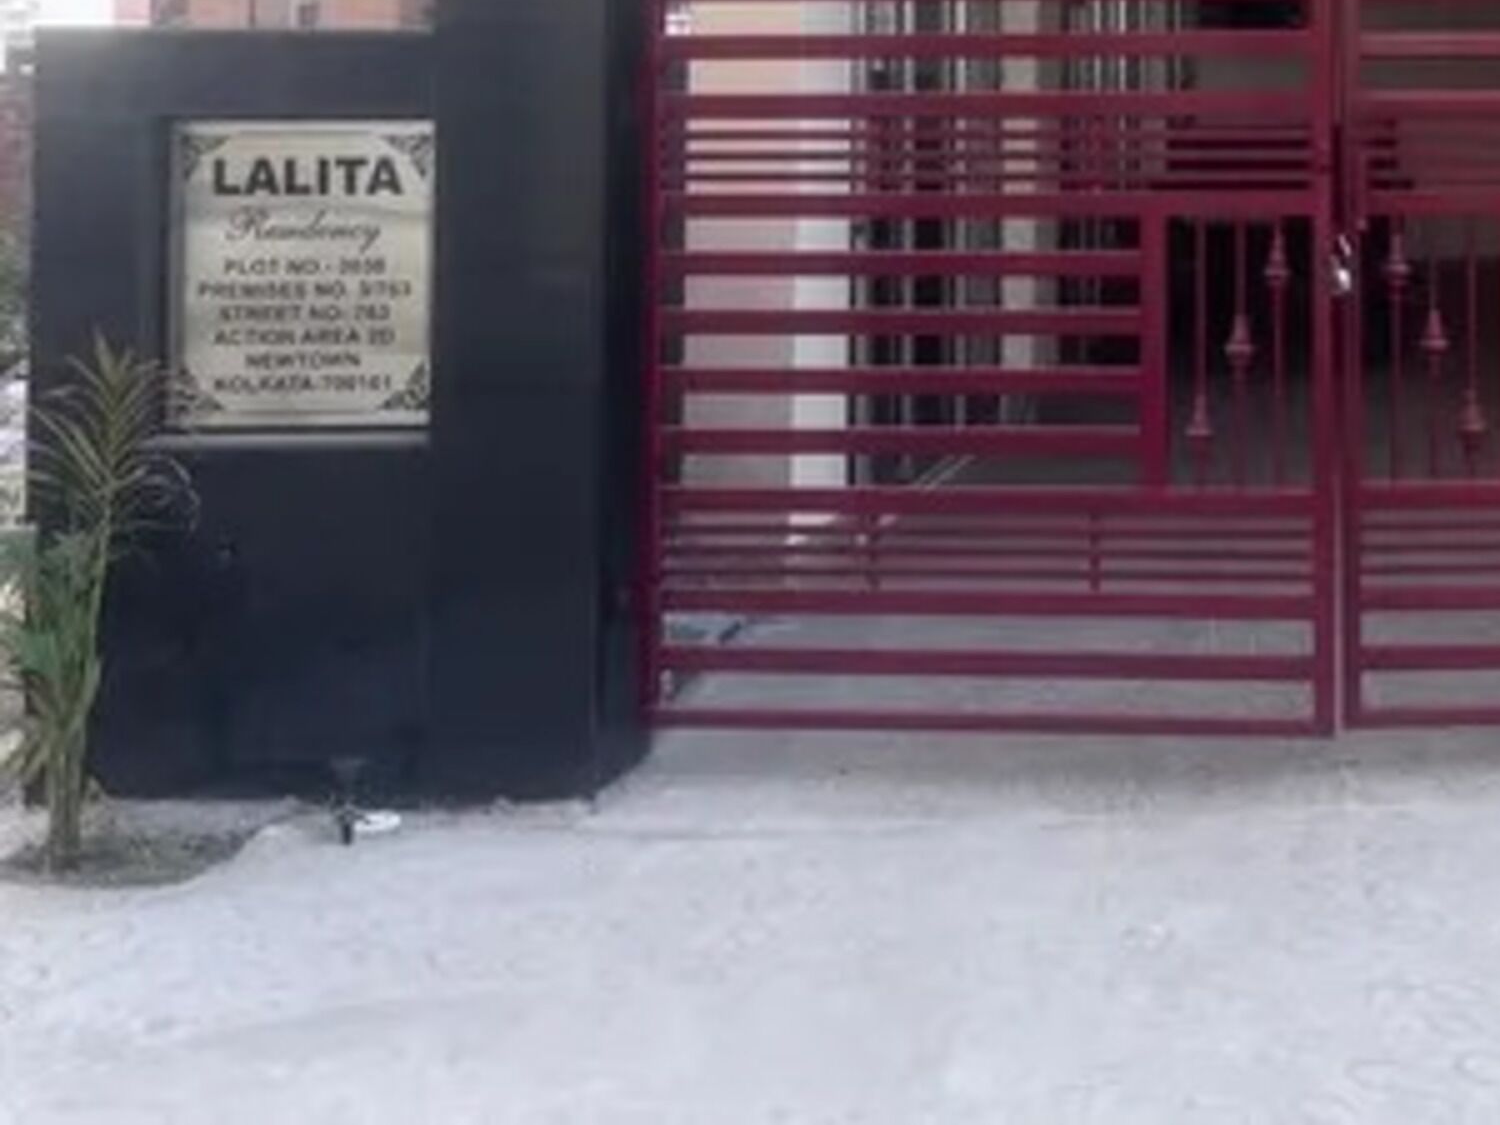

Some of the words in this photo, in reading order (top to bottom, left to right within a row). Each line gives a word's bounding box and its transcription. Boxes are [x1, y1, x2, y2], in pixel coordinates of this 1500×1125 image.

[213, 158, 402, 195] LALITA
[224, 259, 278, 274] PLOT
[199, 281, 306, 299] PREMISES
[220, 306, 301, 322] STREET
[214, 329, 296, 346] ACTION
[300, 329, 361, 345] AREA
